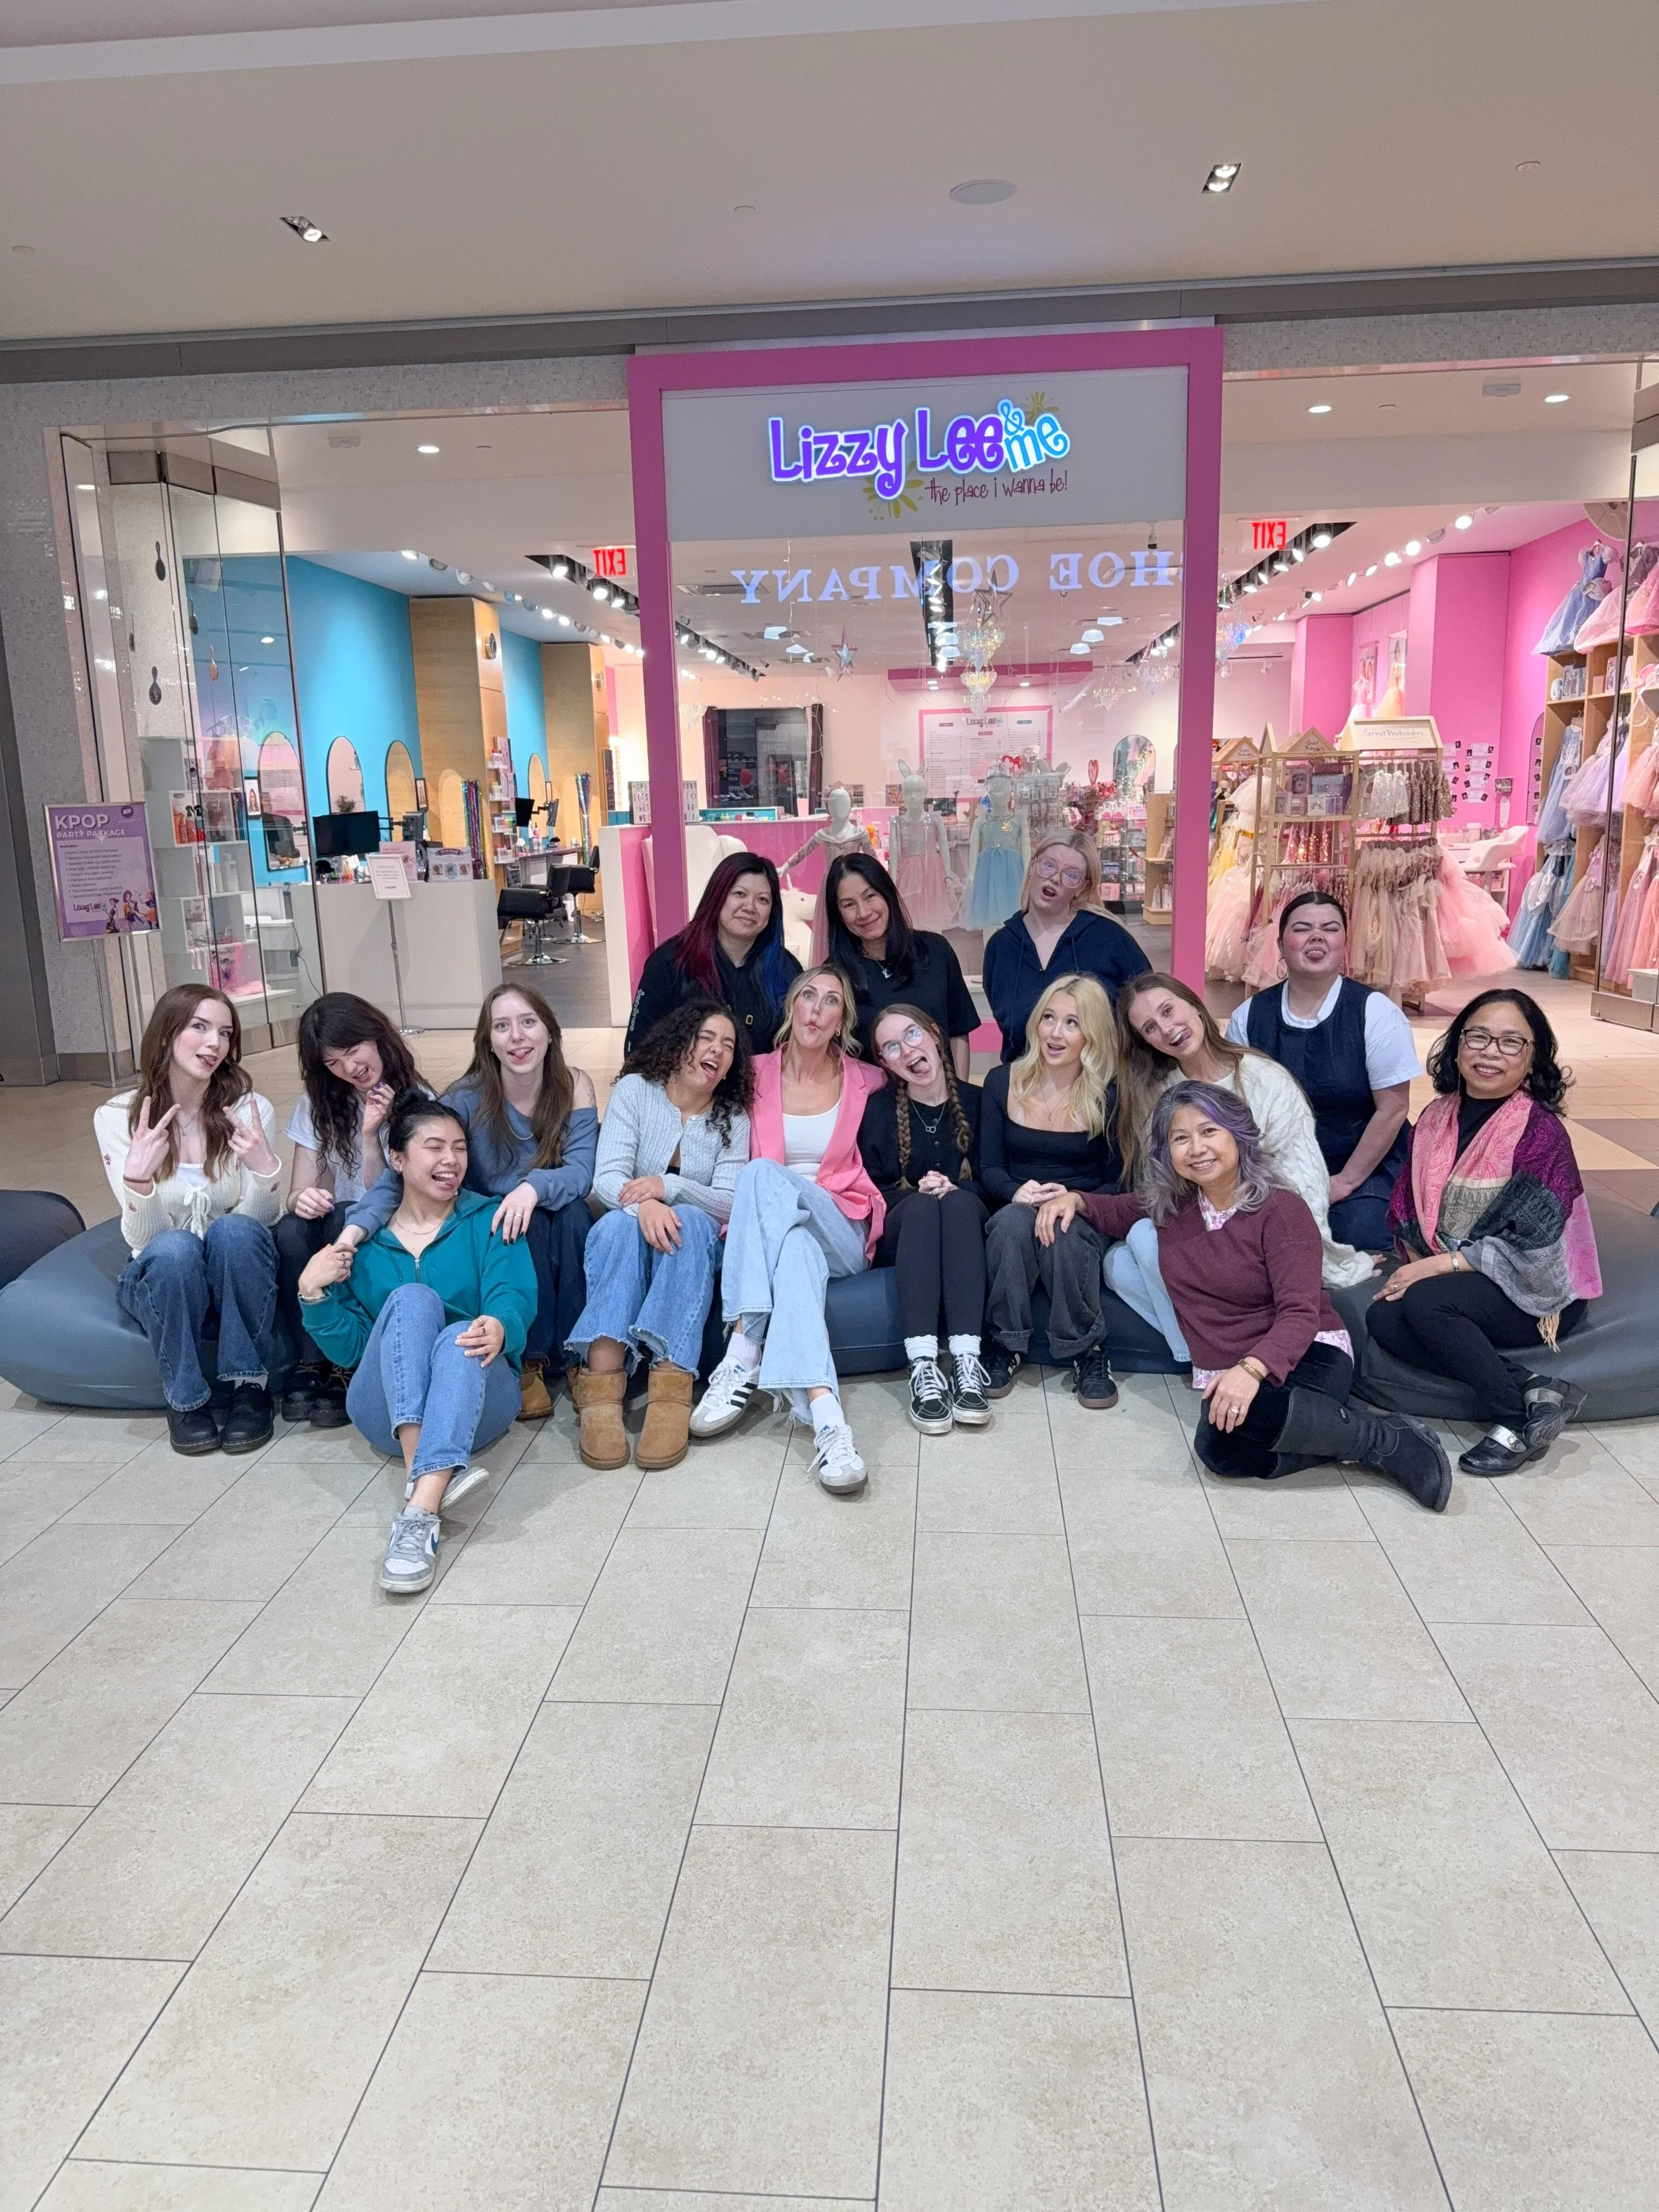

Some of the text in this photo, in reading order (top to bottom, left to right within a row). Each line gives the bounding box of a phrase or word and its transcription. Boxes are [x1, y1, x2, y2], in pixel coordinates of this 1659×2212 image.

[769, 400, 1070, 499] Lizzy Lee & me
[924, 468, 1068, 506] the place i wanna be!
[54, 814, 109, 830] KPOP
[87, 829, 126, 838] PACKAGE
